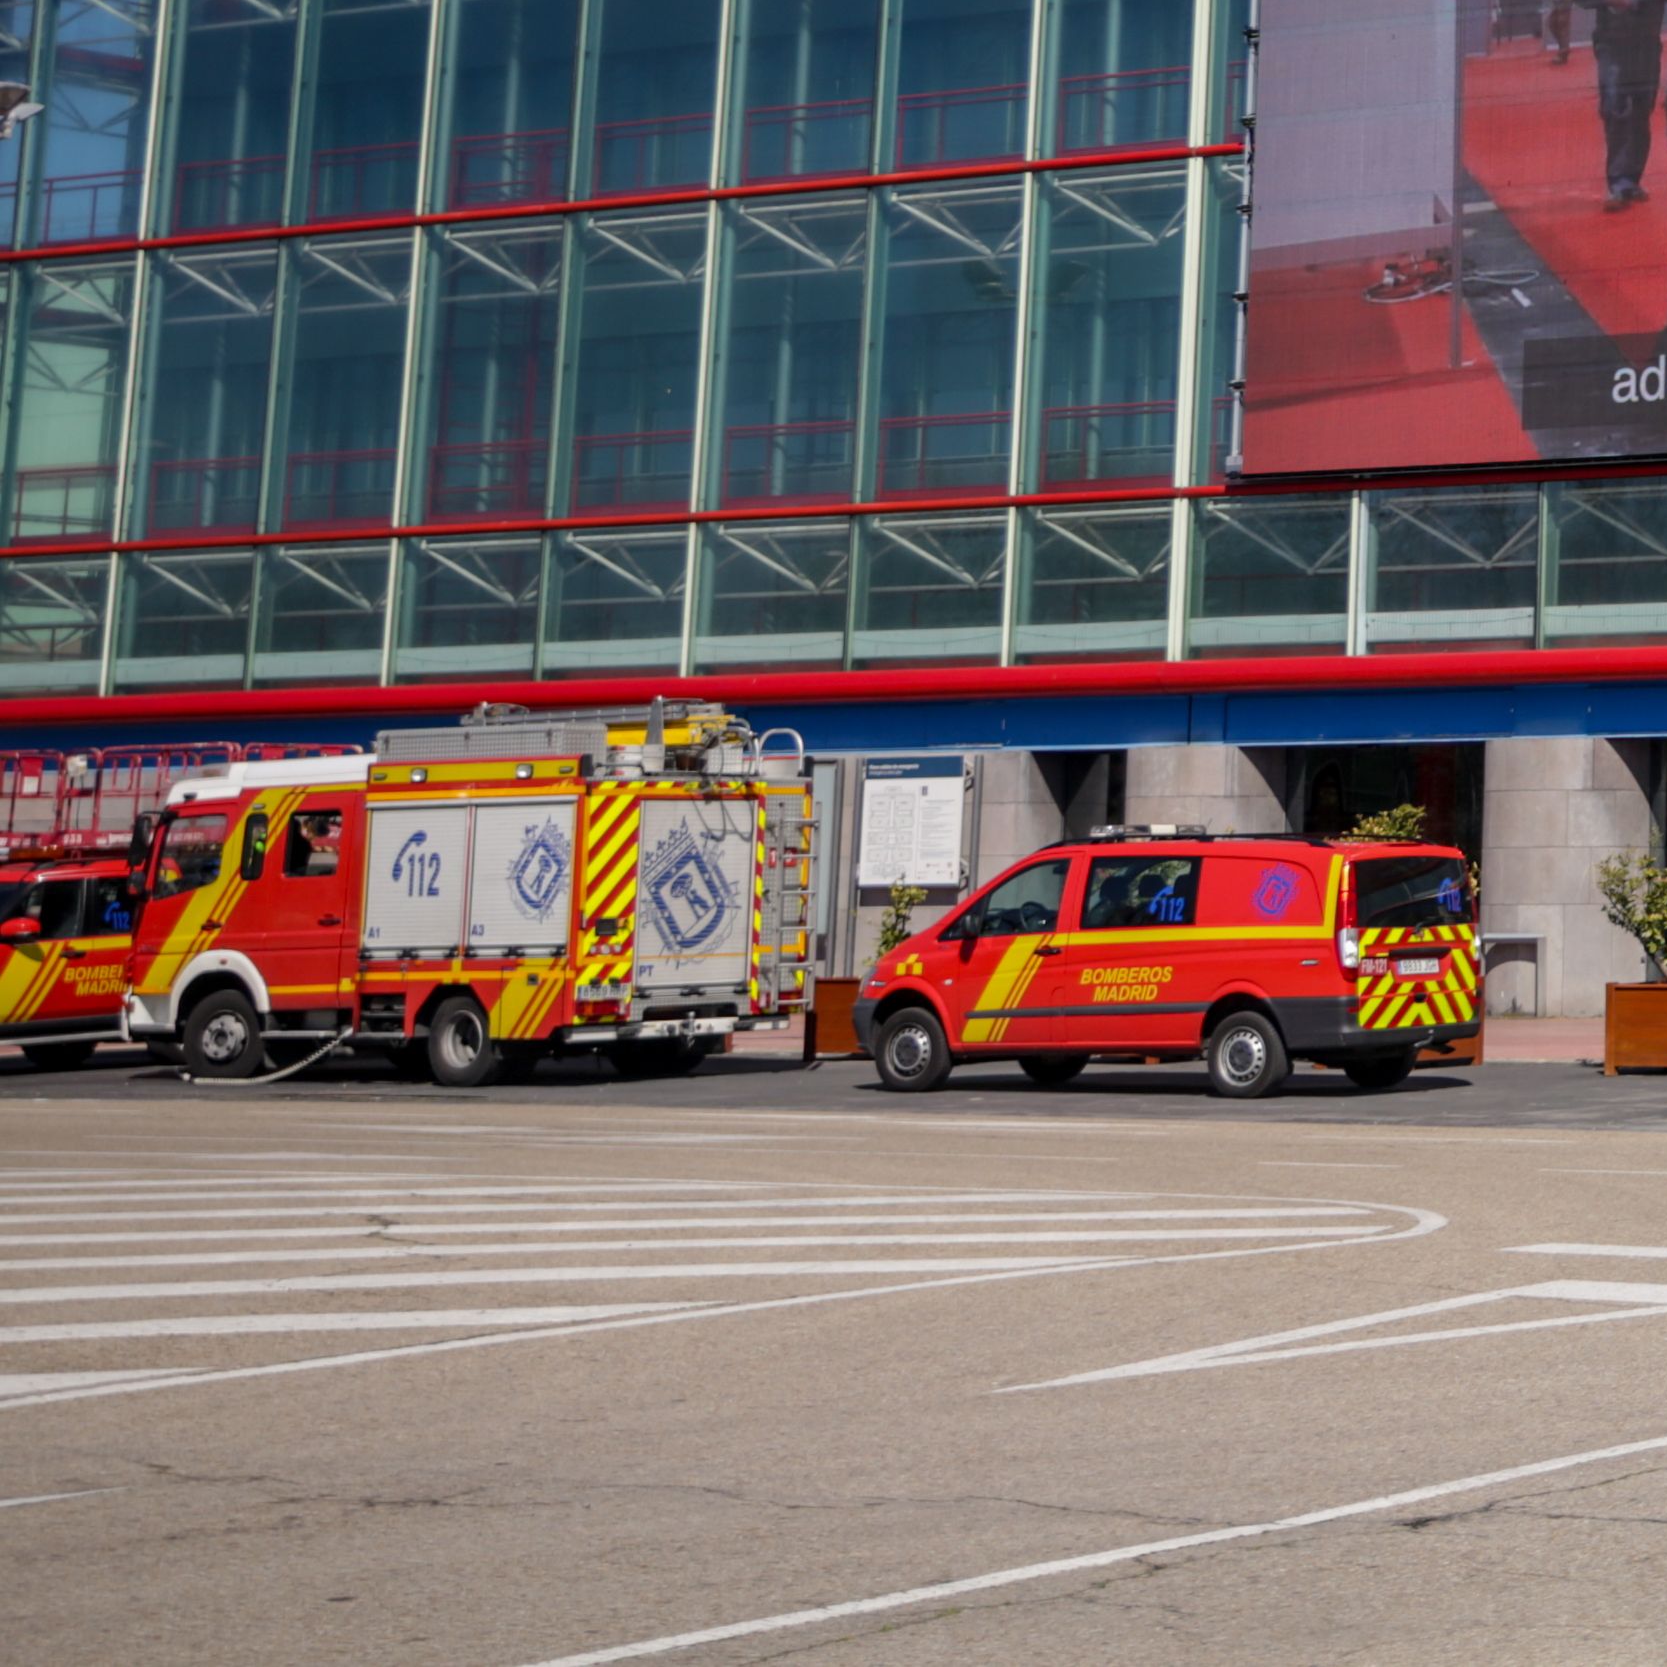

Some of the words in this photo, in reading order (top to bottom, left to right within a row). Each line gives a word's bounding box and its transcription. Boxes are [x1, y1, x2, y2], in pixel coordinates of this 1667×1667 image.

[408, 853, 441, 897] 112
[1160, 896, 1185, 921] 112
[112, 911, 131, 930] 112
[368, 927, 380, 938] A1
[64, 964, 124, 983] BOMBE
[639, 965, 654, 977] PT
[1080, 966, 1173, 985] BOMBEROS
[1093, 984, 1158, 1002] MADRID
